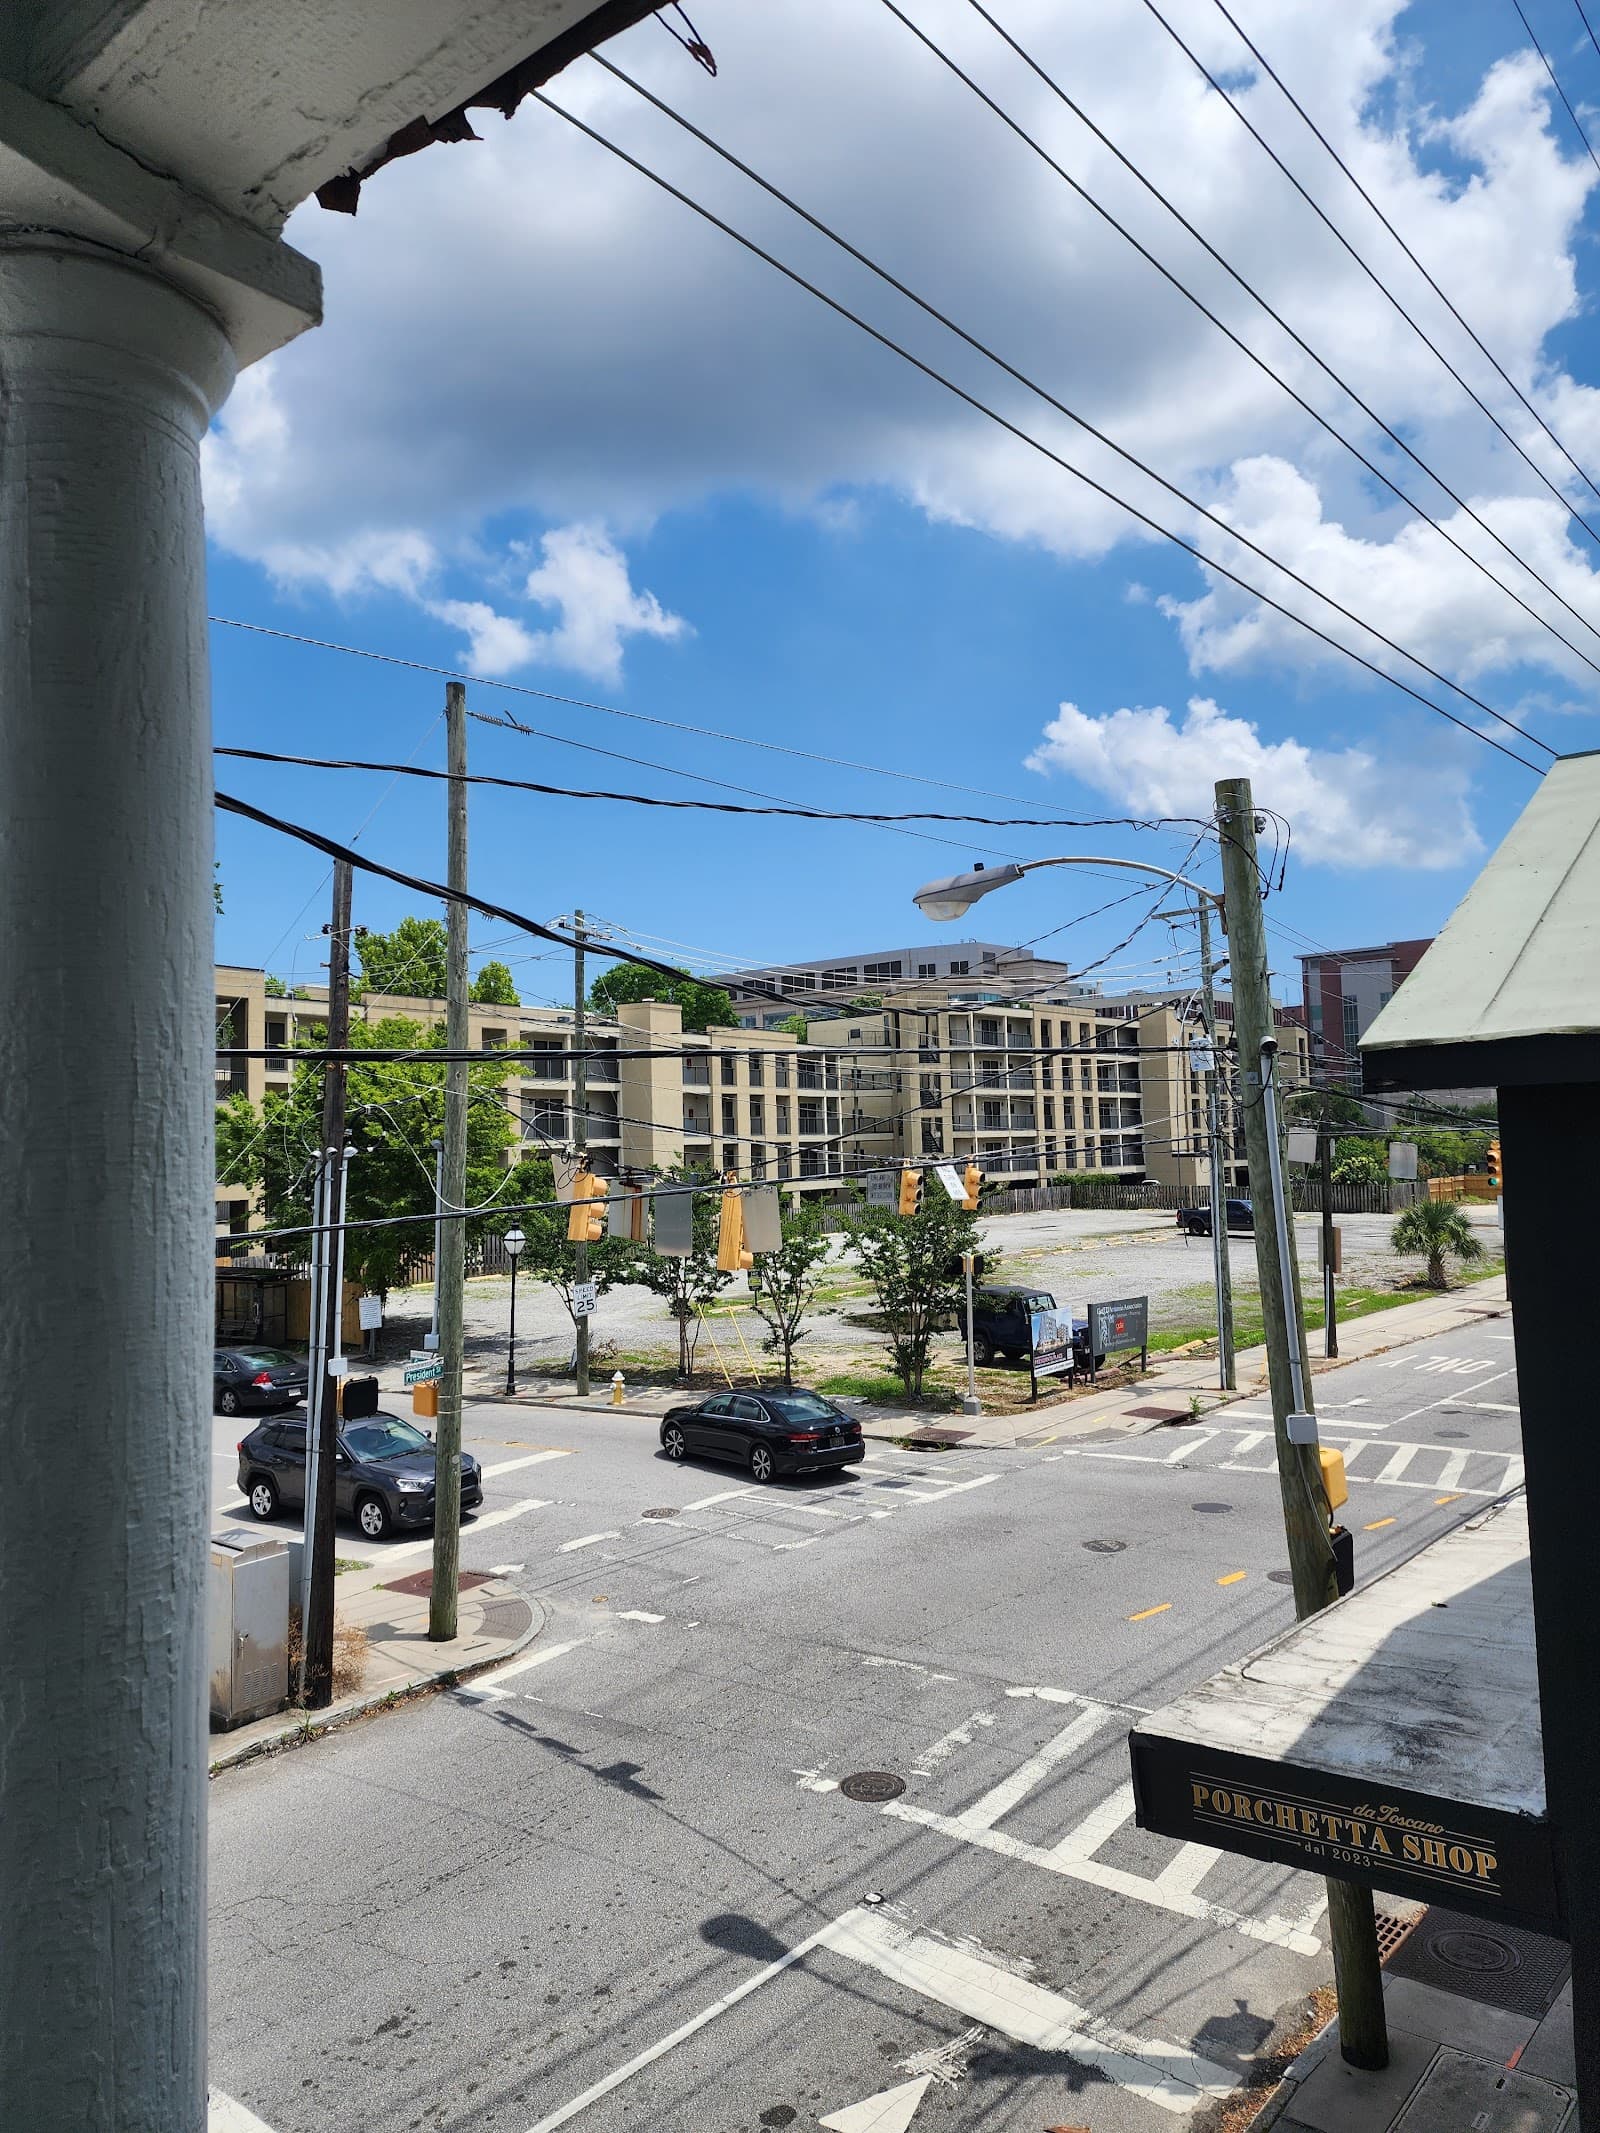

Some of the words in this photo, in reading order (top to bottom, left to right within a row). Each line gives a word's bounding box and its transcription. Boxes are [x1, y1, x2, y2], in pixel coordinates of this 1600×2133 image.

[575, 1286, 594, 1295] SPEED
[577, 1299, 595, 1312] 25
[1376, 1354, 1496, 1374] ONLY
[406, 1368, 435, 1383] President
[1353, 1803, 1376, 1818] da
[1375, 1804, 1445, 1834] Toscano
[1190, 1783, 1393, 1855] PORCHETTA
[1402, 1834, 1499, 1880] SHOP
[1304, 1841, 1326, 1856] dal
[1332, 1847, 1371, 1868] 2023
